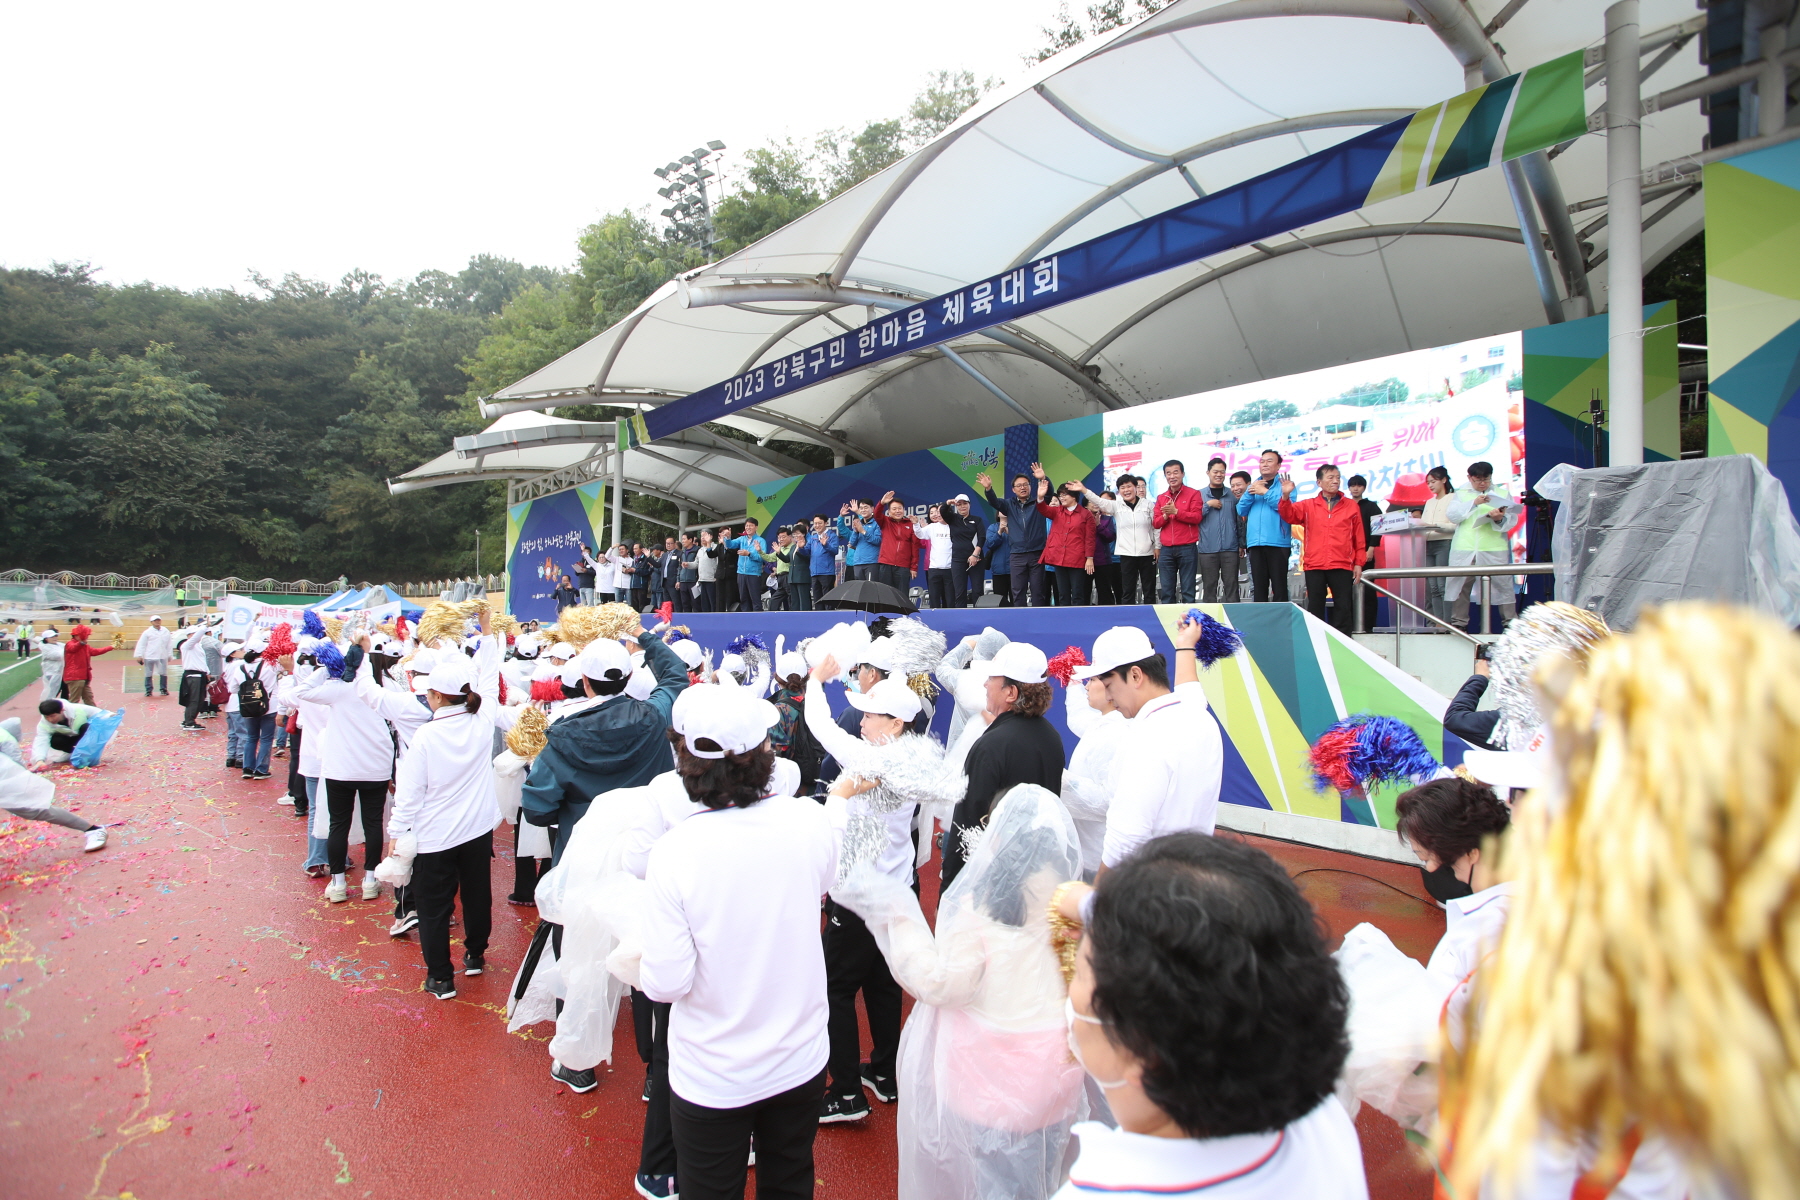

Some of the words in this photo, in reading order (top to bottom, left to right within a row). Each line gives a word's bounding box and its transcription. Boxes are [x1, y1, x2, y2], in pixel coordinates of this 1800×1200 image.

[724, 369, 764, 405] 2023
[773, 337, 845, 388] 강북구민
[858, 307, 927, 358] 한마음
[942, 256, 1059, 325] 체육대회
[1390, 416, 1441, 452] 위해
[979, 447, 999, 469] 강북
